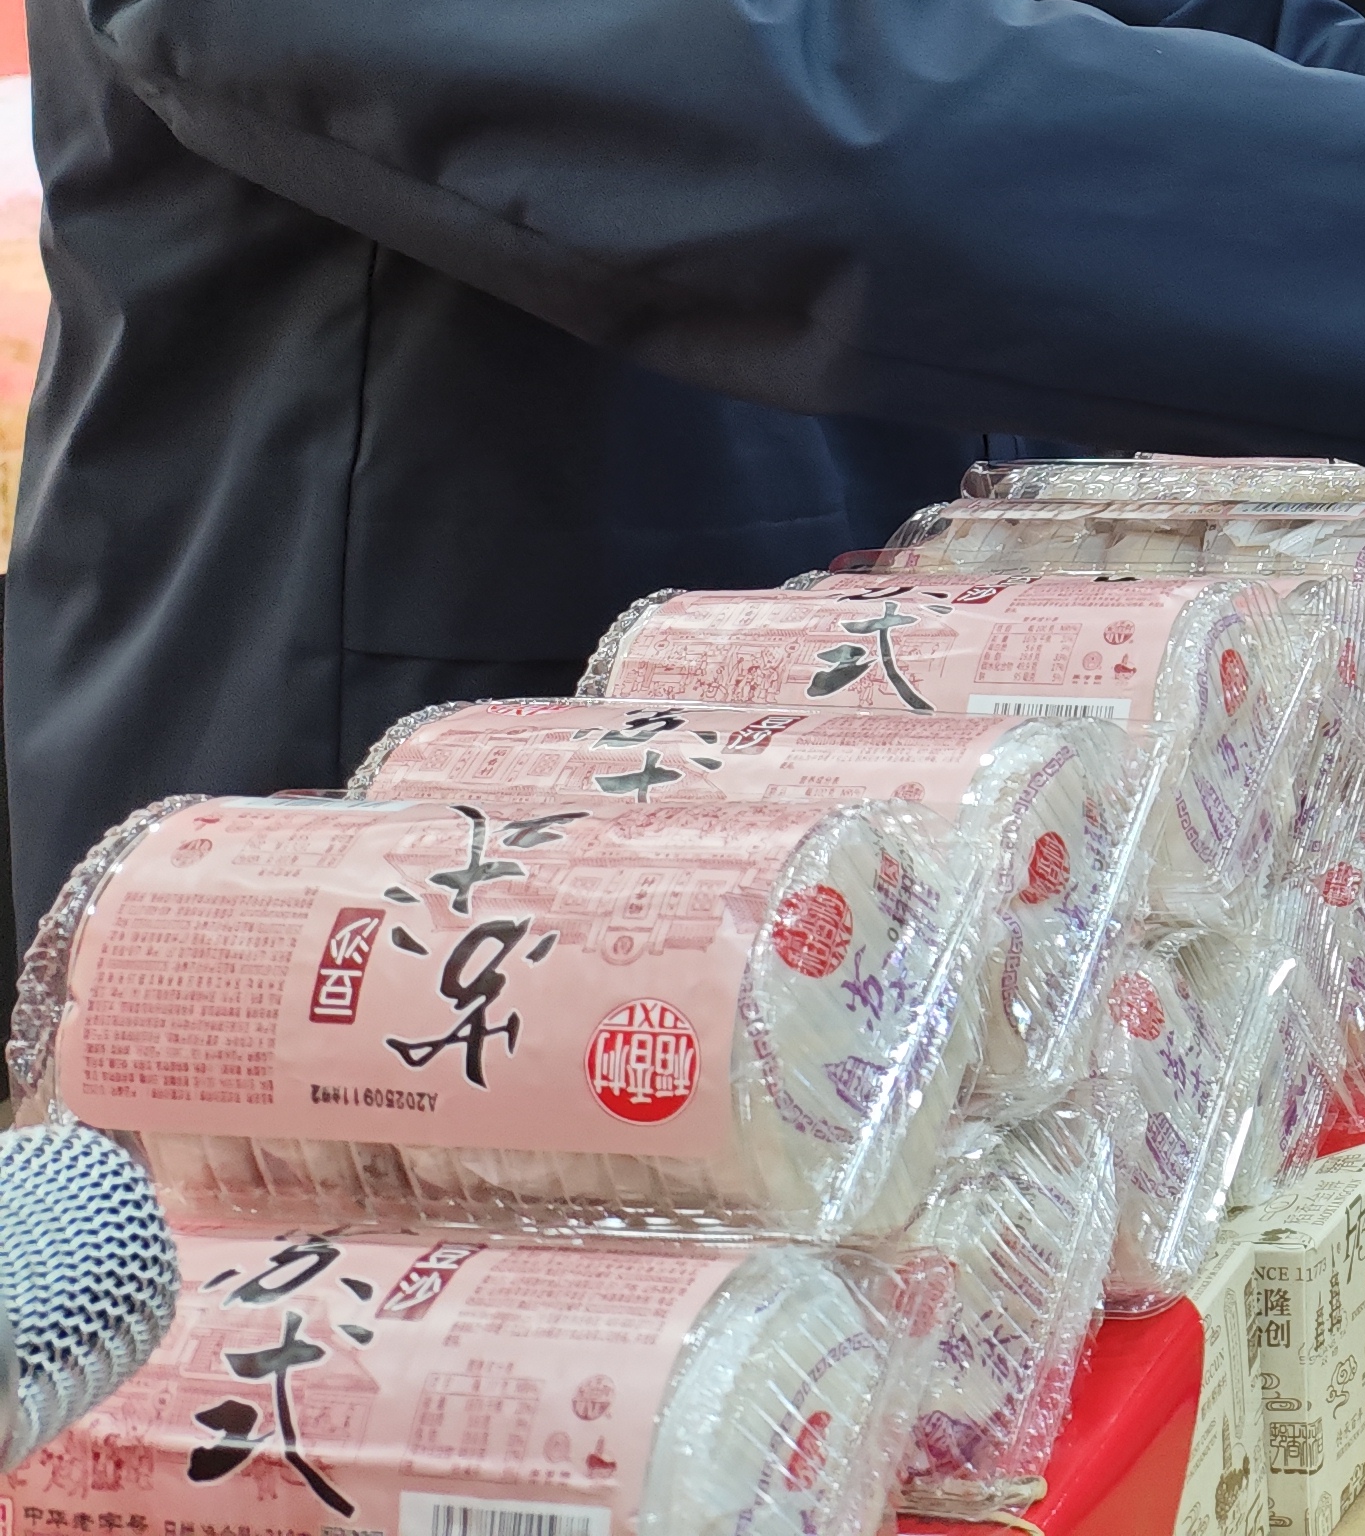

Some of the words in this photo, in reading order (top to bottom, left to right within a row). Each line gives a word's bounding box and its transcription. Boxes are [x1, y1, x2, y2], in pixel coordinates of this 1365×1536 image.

[727, 715, 802, 750] 豆沙
[314, 915, 380, 1016] 豆沙
[1254, 1266, 1289, 1282] NCE
